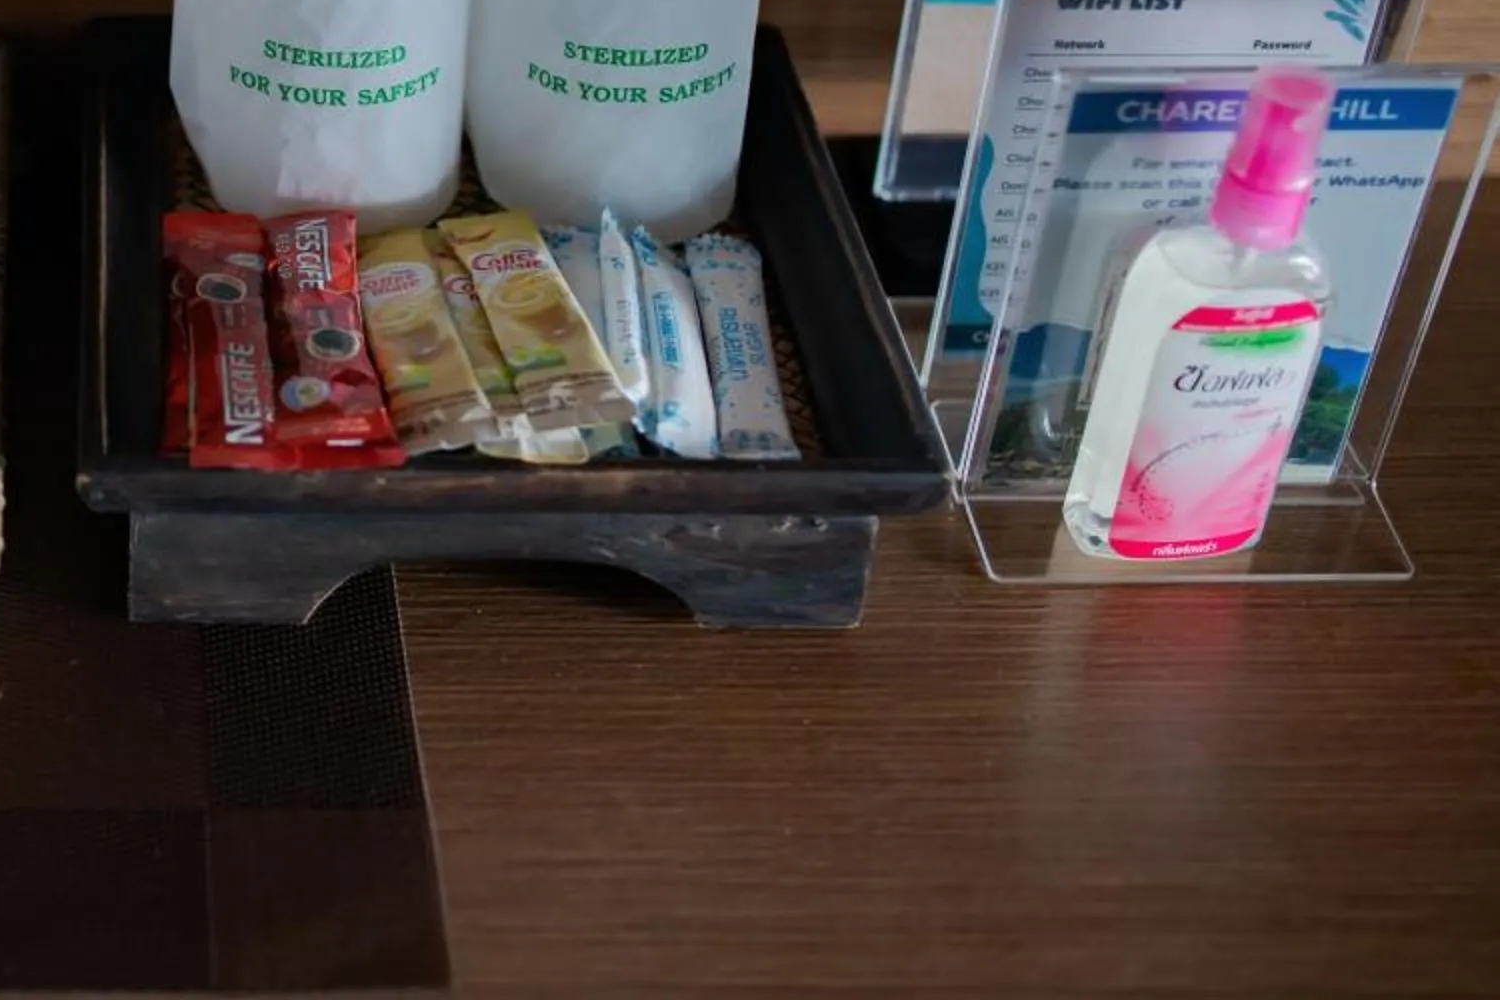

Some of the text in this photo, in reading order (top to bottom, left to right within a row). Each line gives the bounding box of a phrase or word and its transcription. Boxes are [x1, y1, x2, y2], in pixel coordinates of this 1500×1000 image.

[262, 39, 407, 69] STERILIZED
[563, 40, 709, 68] STERILIZED
[1054, 39, 1312, 51] Network Password
[229, 64, 441, 107] FOR YOUR SAFETY
[527, 61, 737, 104] FOR YOUR SAFETY
[1116, 99, 1242, 122] CHARE
[1329, 174, 1425, 190] WhatsApp
